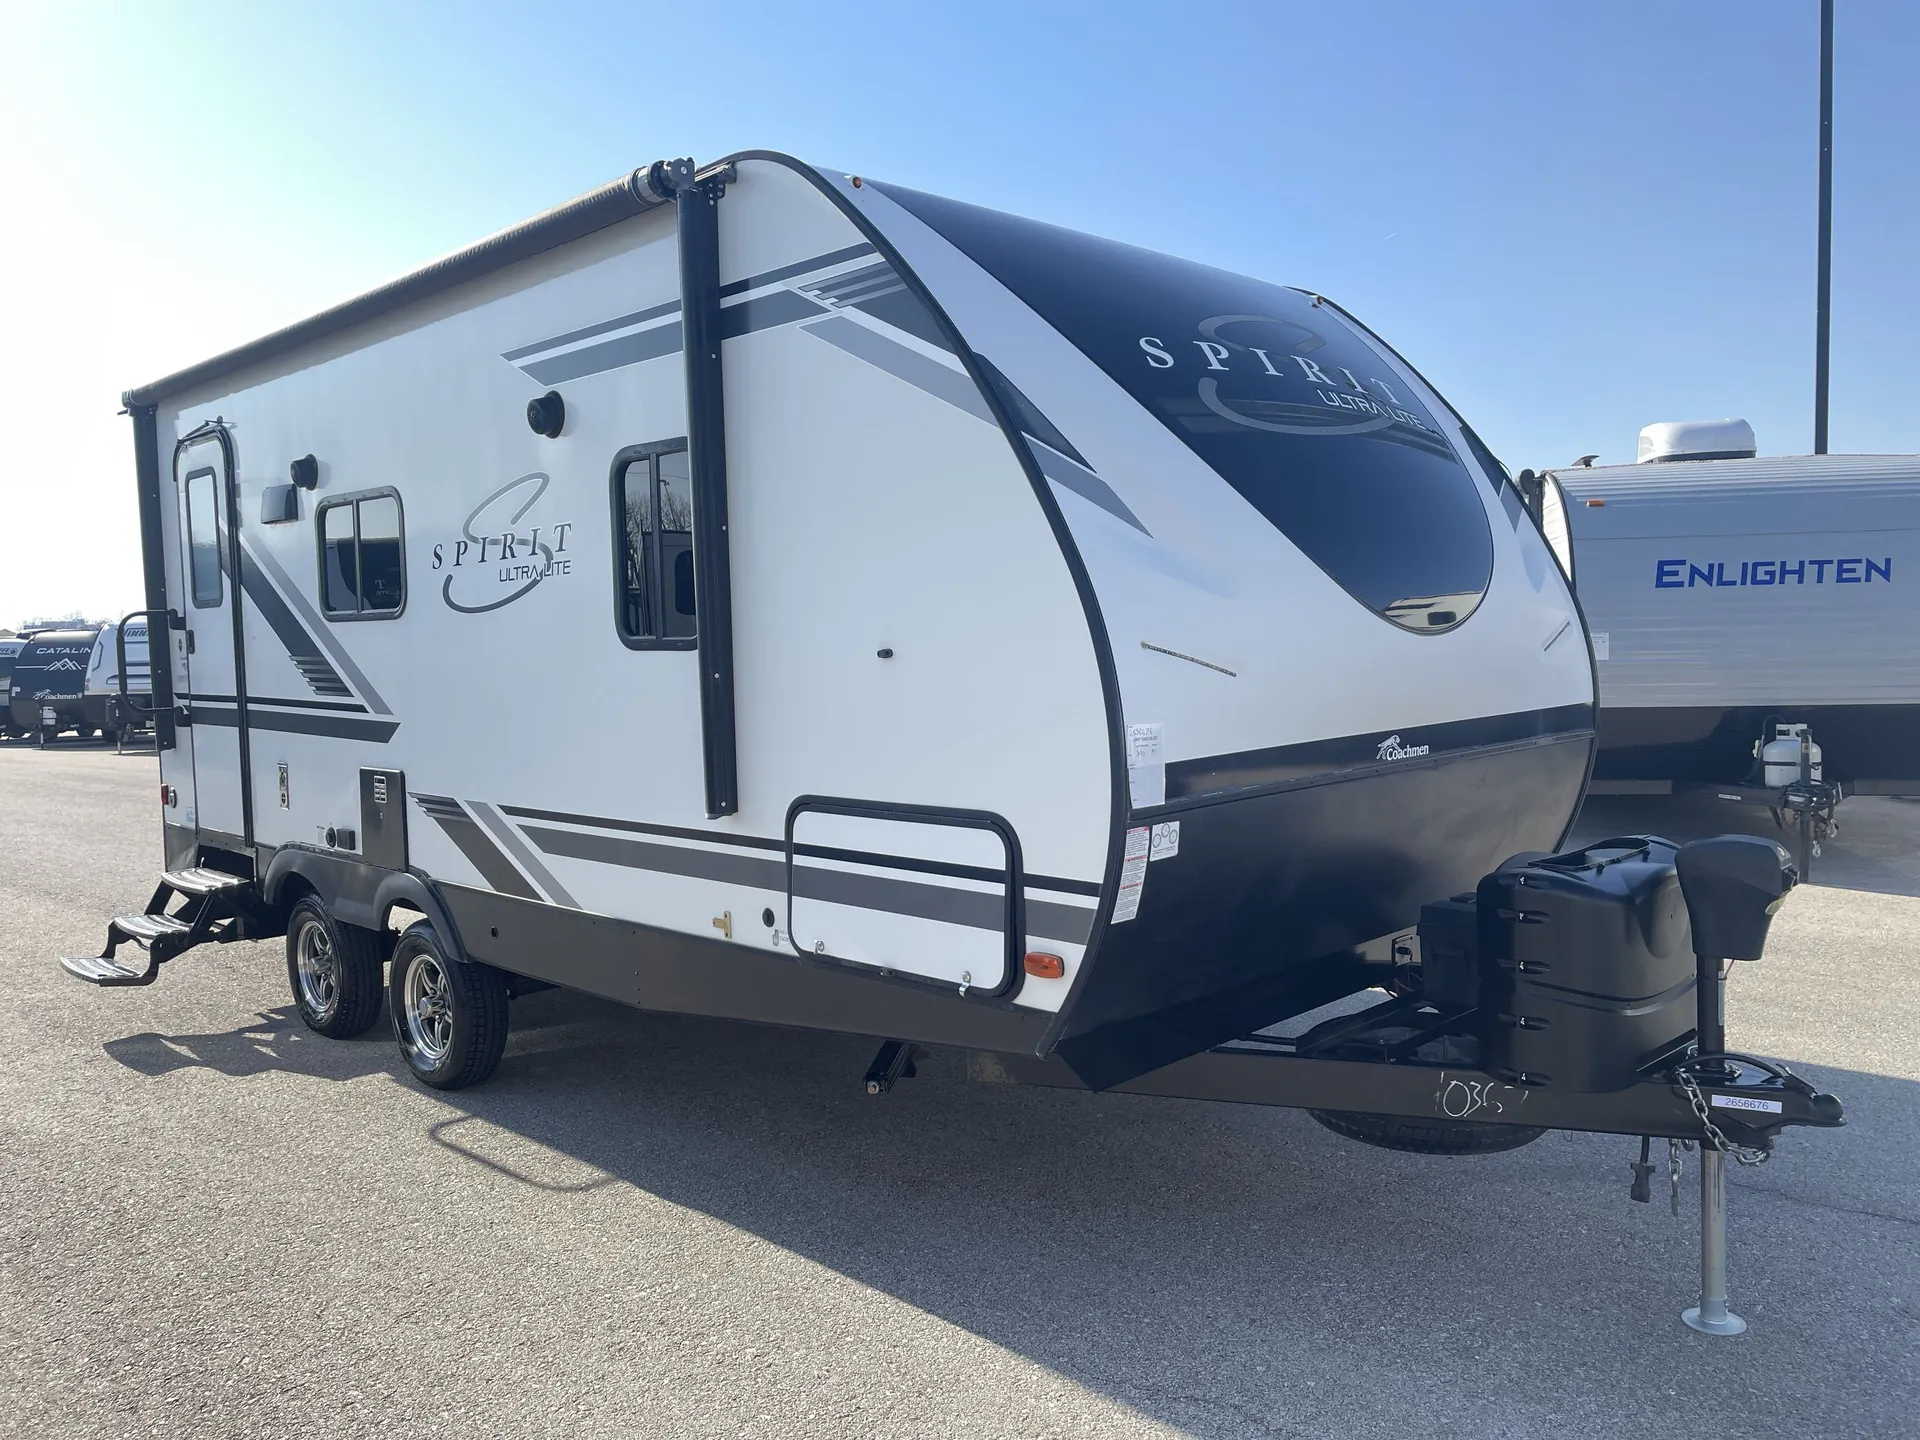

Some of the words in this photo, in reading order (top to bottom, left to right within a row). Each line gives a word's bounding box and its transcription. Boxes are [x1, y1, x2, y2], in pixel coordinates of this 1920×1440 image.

[1138, 336, 1403, 406] SPIRIT
[1316, 389, 1389, 418] ULTRA
[1385, 405, 1427, 430] LITE
[432, 523, 572, 570] SPIRIT
[499, 565, 540, 582] ULTRA
[543, 560, 571, 577] LITE
[1654, 557, 1892, 588] ENLIGHTEN
[1386, 744, 1429, 761] Coachmen
[1725, 1098, 1769, 1110] 2656676
